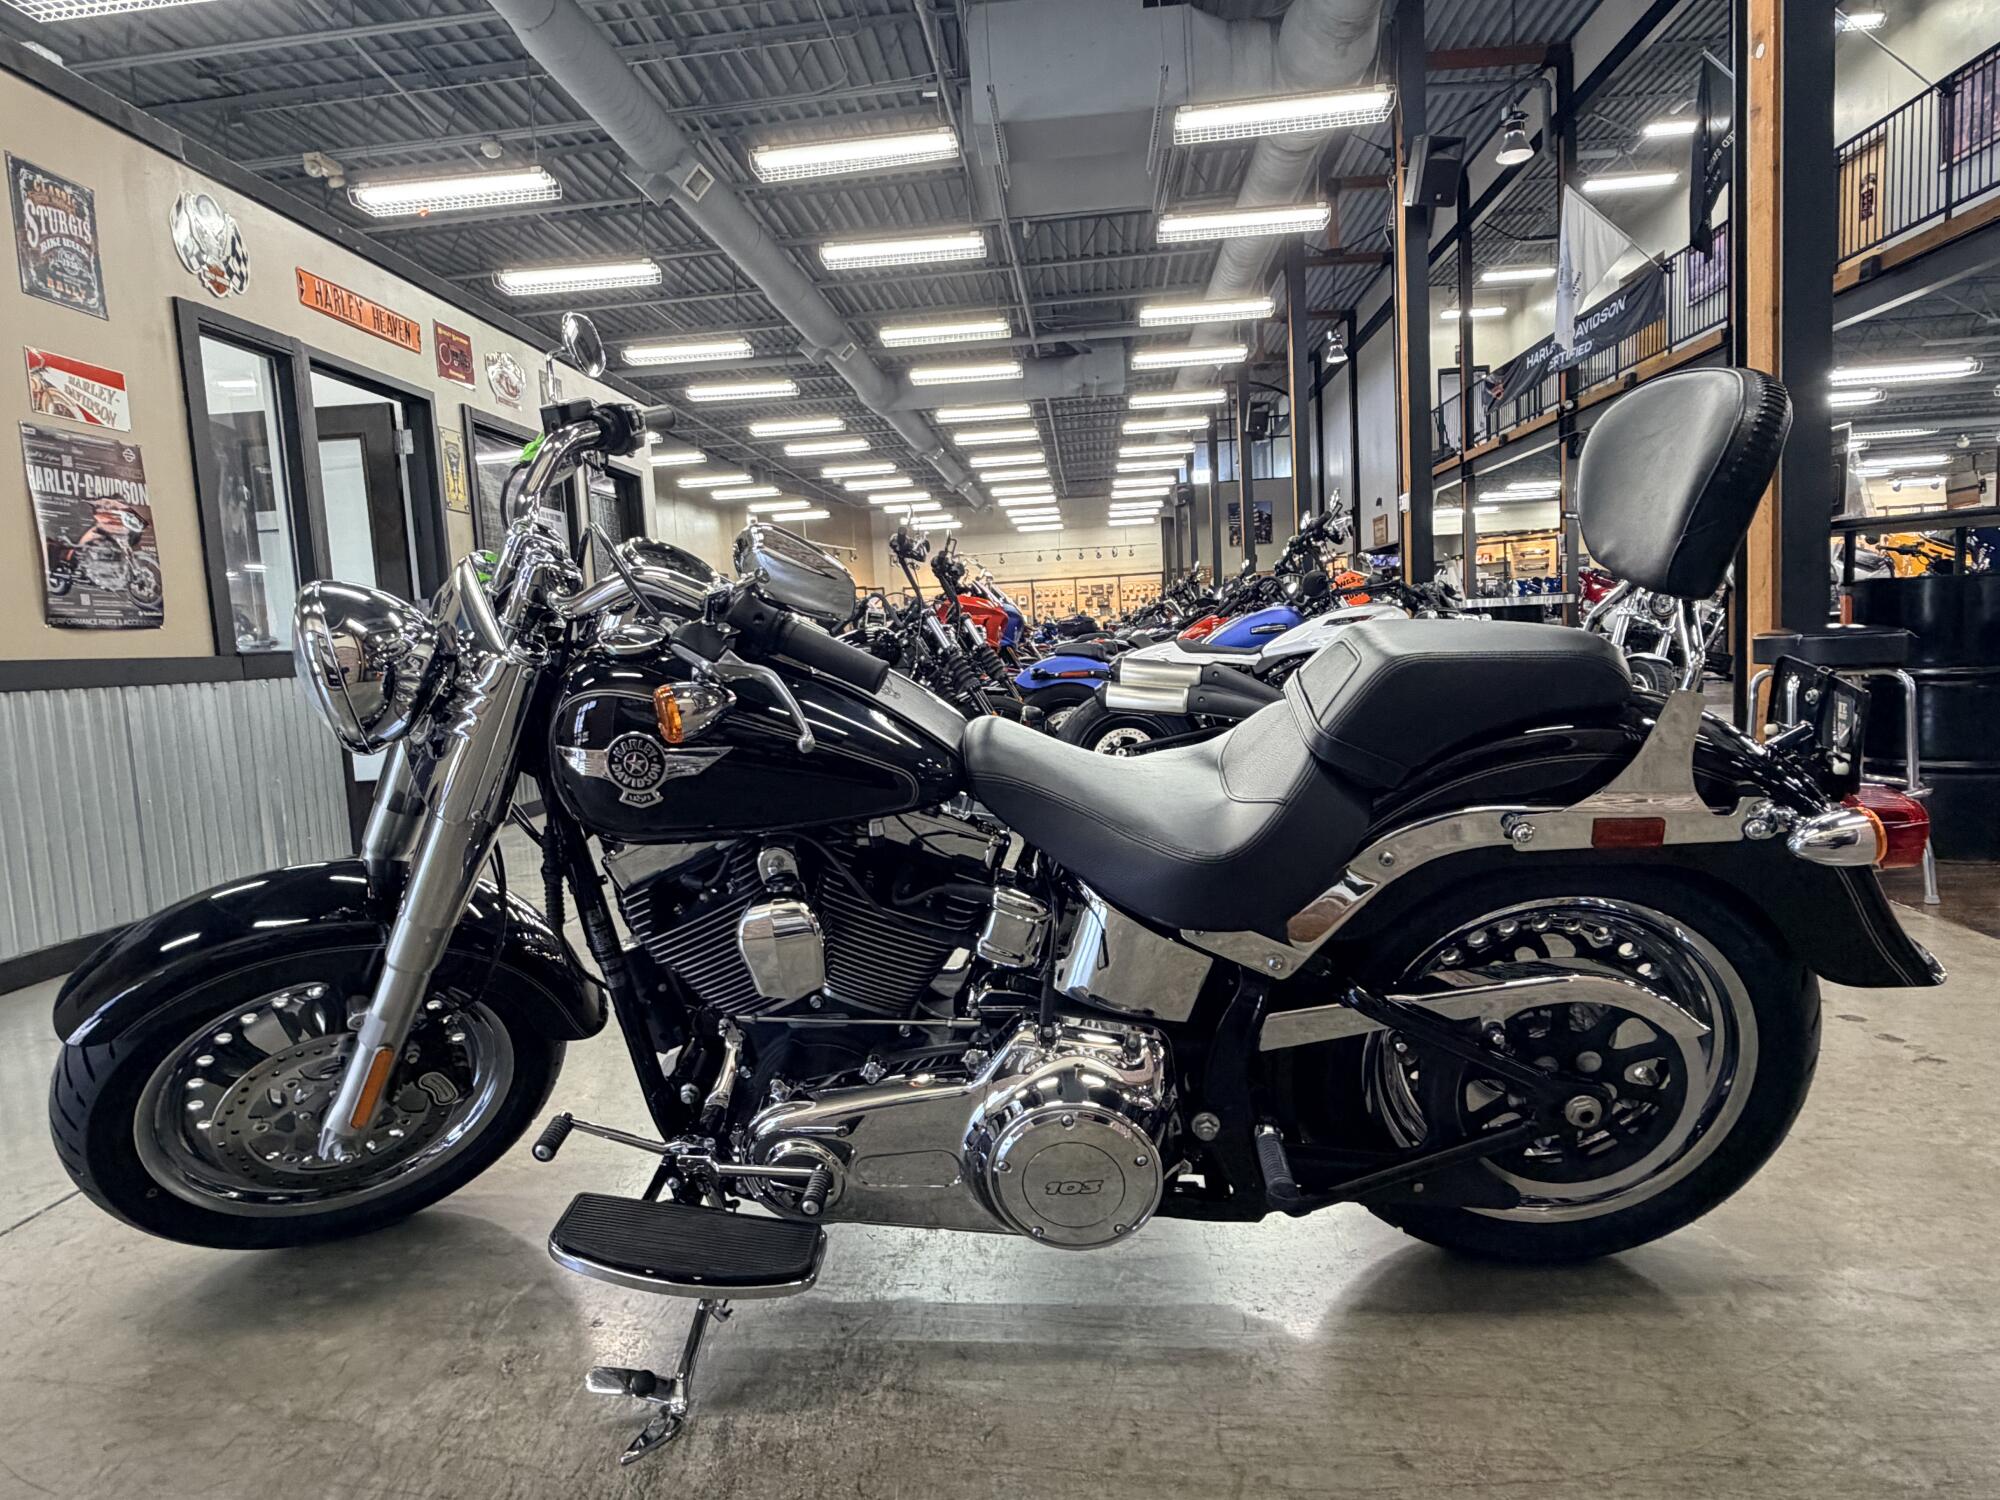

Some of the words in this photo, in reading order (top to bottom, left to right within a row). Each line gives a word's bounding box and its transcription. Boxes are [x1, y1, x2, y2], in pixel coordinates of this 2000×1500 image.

[24, 198, 92, 248] STURGIS
[314, 279, 363, 324] HARLEY
[371, 305, 413, 346] HEAVEN
[64, 384, 117, 428] DAVIDSON
[26, 464, 150, 506] HARLEY-DAVIDSON
[612, 738, 659, 759] HARLEY
[611, 763, 662, 788] DAVIDSON
[1045, 1180, 1104, 1195] 103
